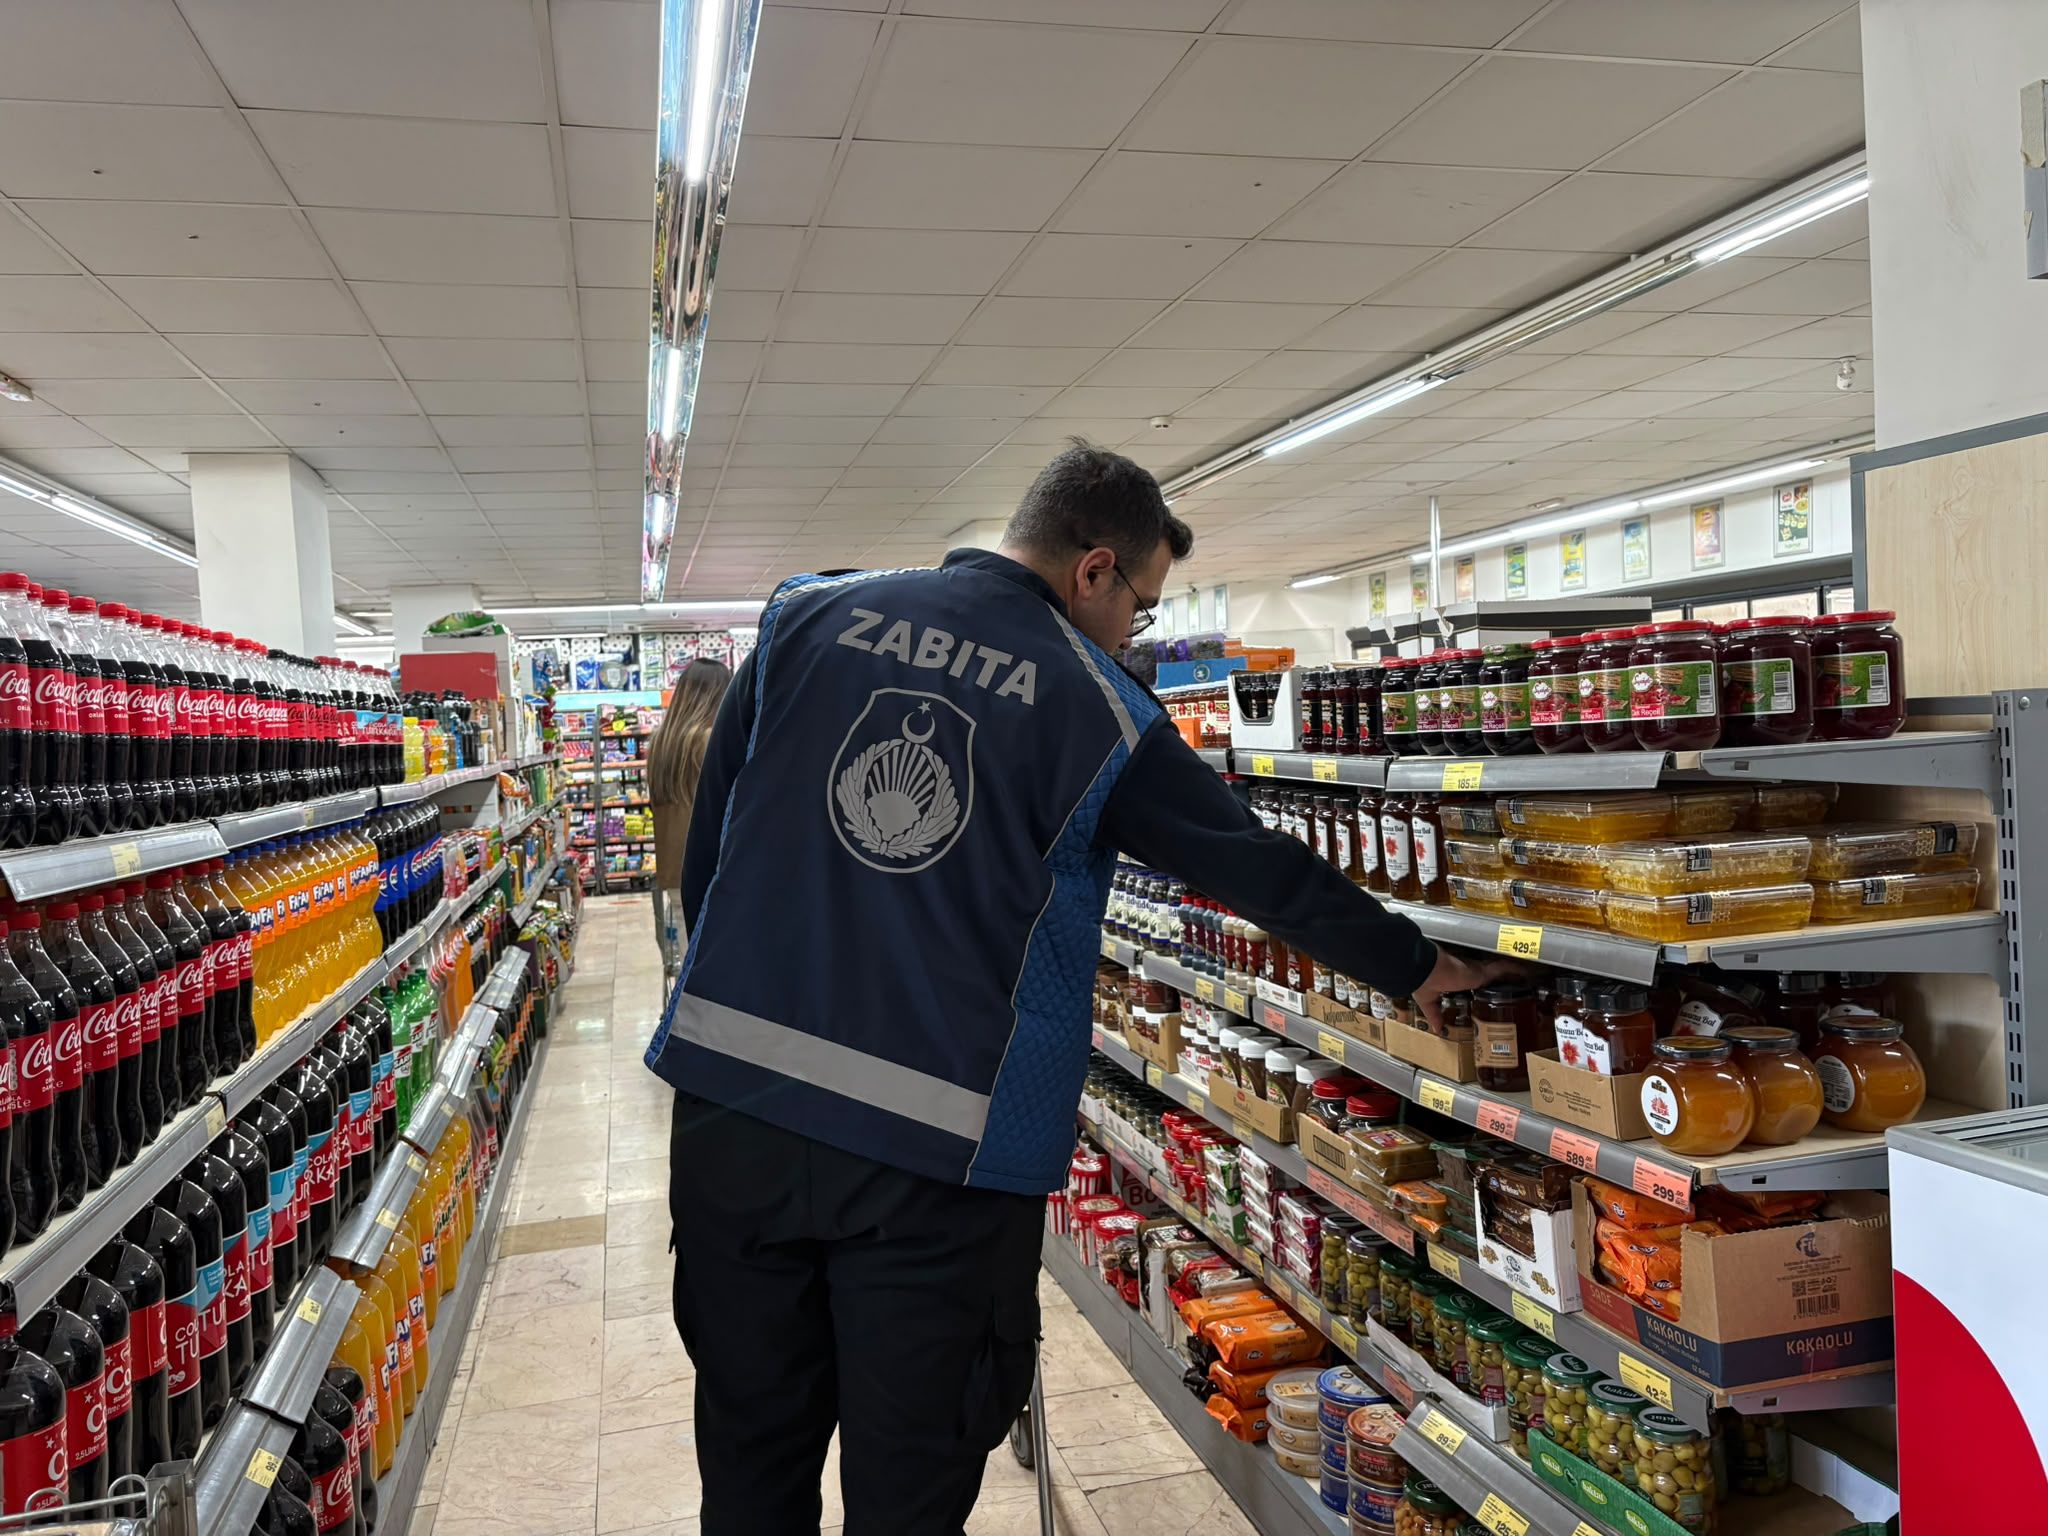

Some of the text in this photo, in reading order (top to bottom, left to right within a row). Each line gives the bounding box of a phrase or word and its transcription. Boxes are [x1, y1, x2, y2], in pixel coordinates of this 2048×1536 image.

[836, 607, 1037, 706] ZABITA
[1513, 941, 1529, 954] 429
[1432, 1097, 1445, 1110] 199
[1489, 1119, 1506, 1134] 299
[1566, 1150, 1586, 1168] 589
[1653, 1183, 1675, 1202] 299
[1646, 1315, 1697, 1352] KAKAOLU
[1786, 1330, 1853, 1356] KAKAOLU
[1645, 1384, 1660, 1401] 42
[1436, 1433, 1449, 1446] 89
[1494, 1520, 1511, 1536] 125
